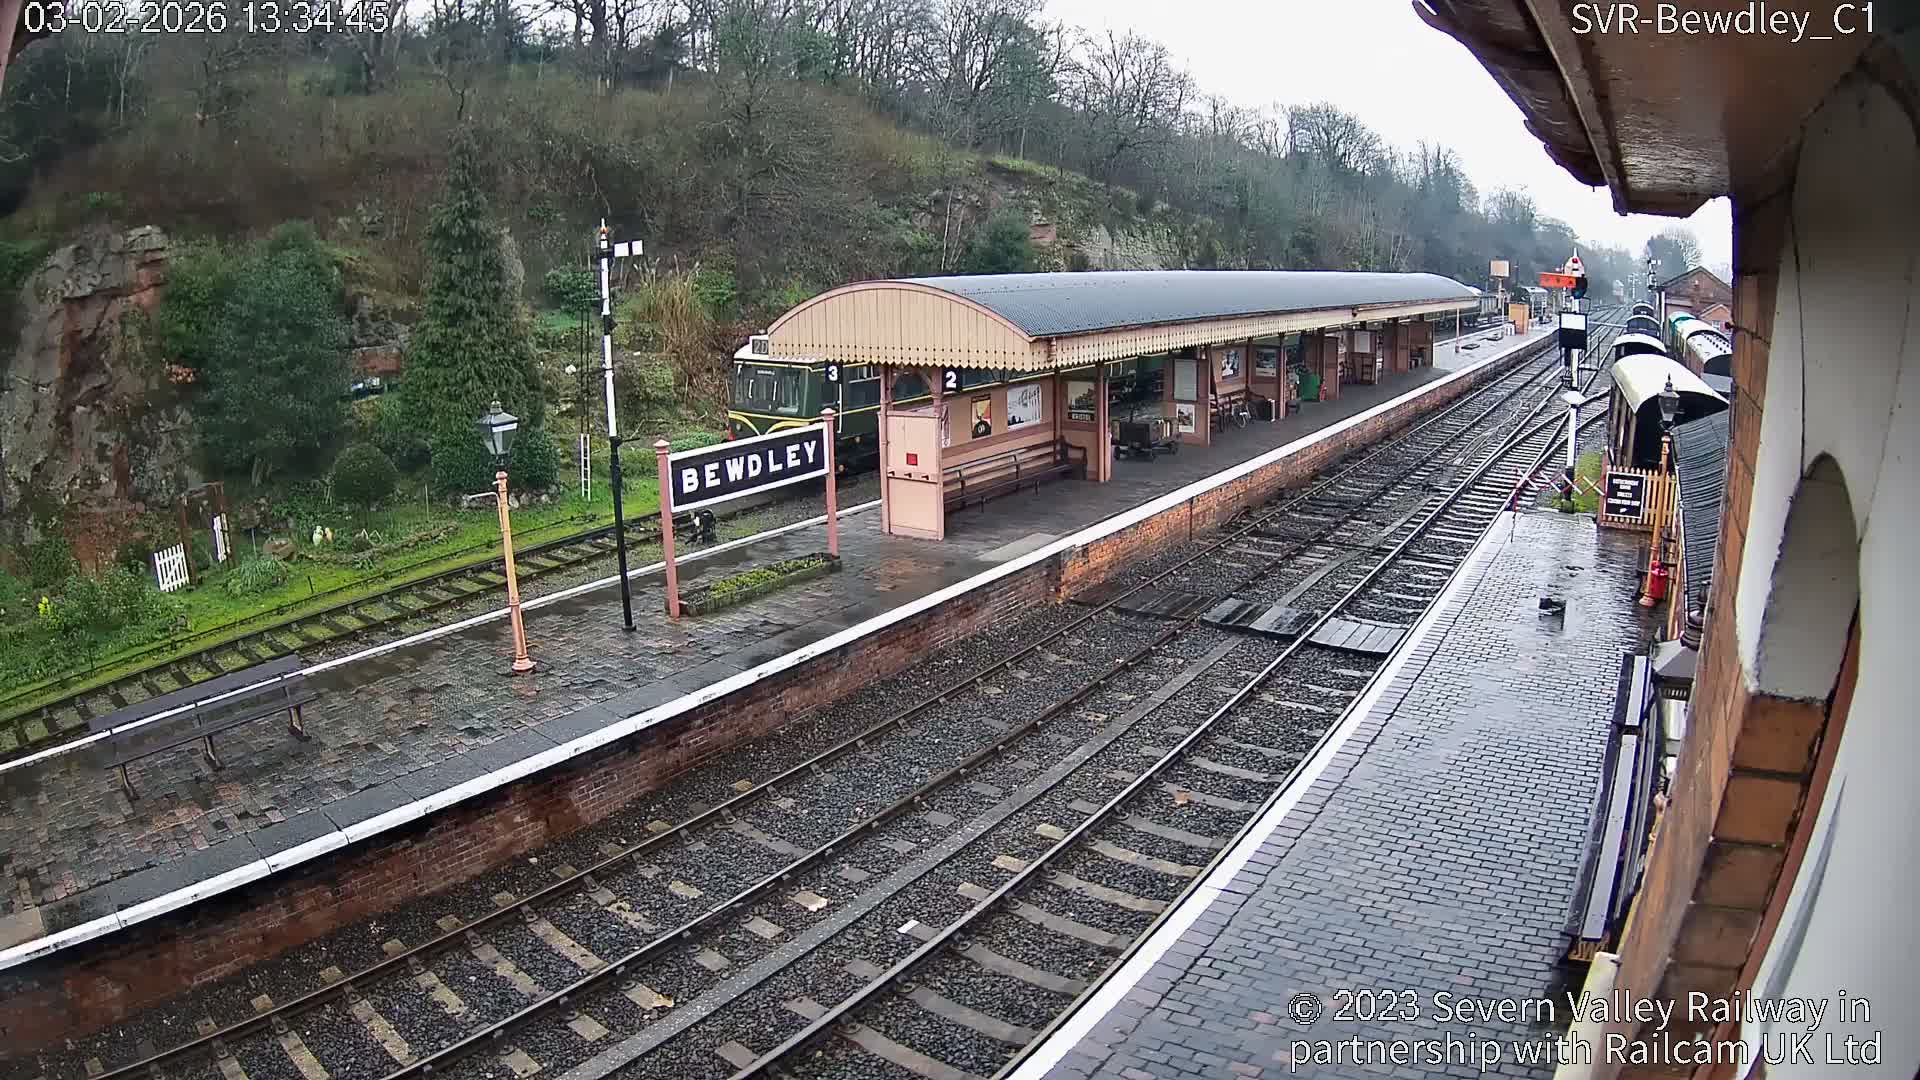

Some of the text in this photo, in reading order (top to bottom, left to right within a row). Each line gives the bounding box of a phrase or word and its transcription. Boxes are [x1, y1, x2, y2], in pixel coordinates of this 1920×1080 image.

[828, 365, 839, 381] 3
[945, 371, 957, 388] 2
[681, 440, 817, 494] BEWDLEY
